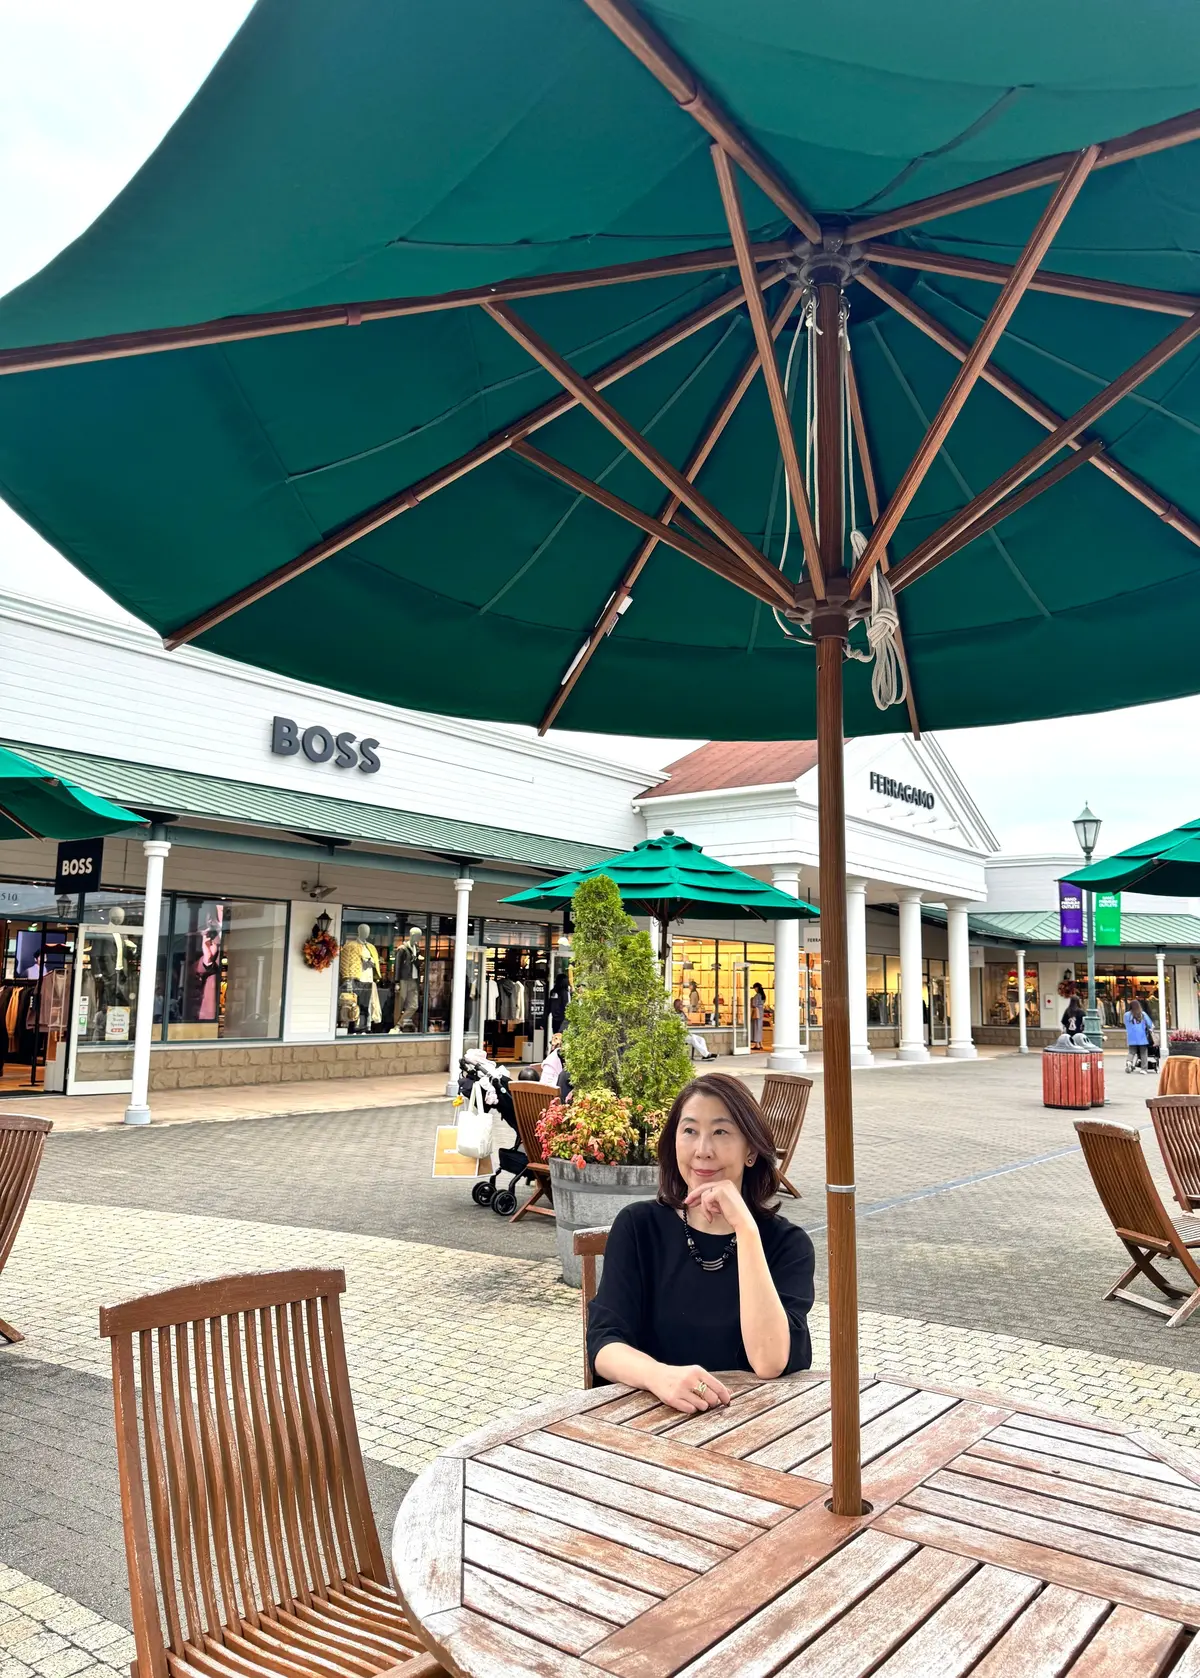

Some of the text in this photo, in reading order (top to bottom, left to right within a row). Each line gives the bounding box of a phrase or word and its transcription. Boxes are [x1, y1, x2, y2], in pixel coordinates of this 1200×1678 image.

[272, 716, 380, 773] BOSS
[870, 771, 934, 810] FERRAGAMO
[62, 857, 93, 876] BOSS
[1, 892, 18, 901] 510
